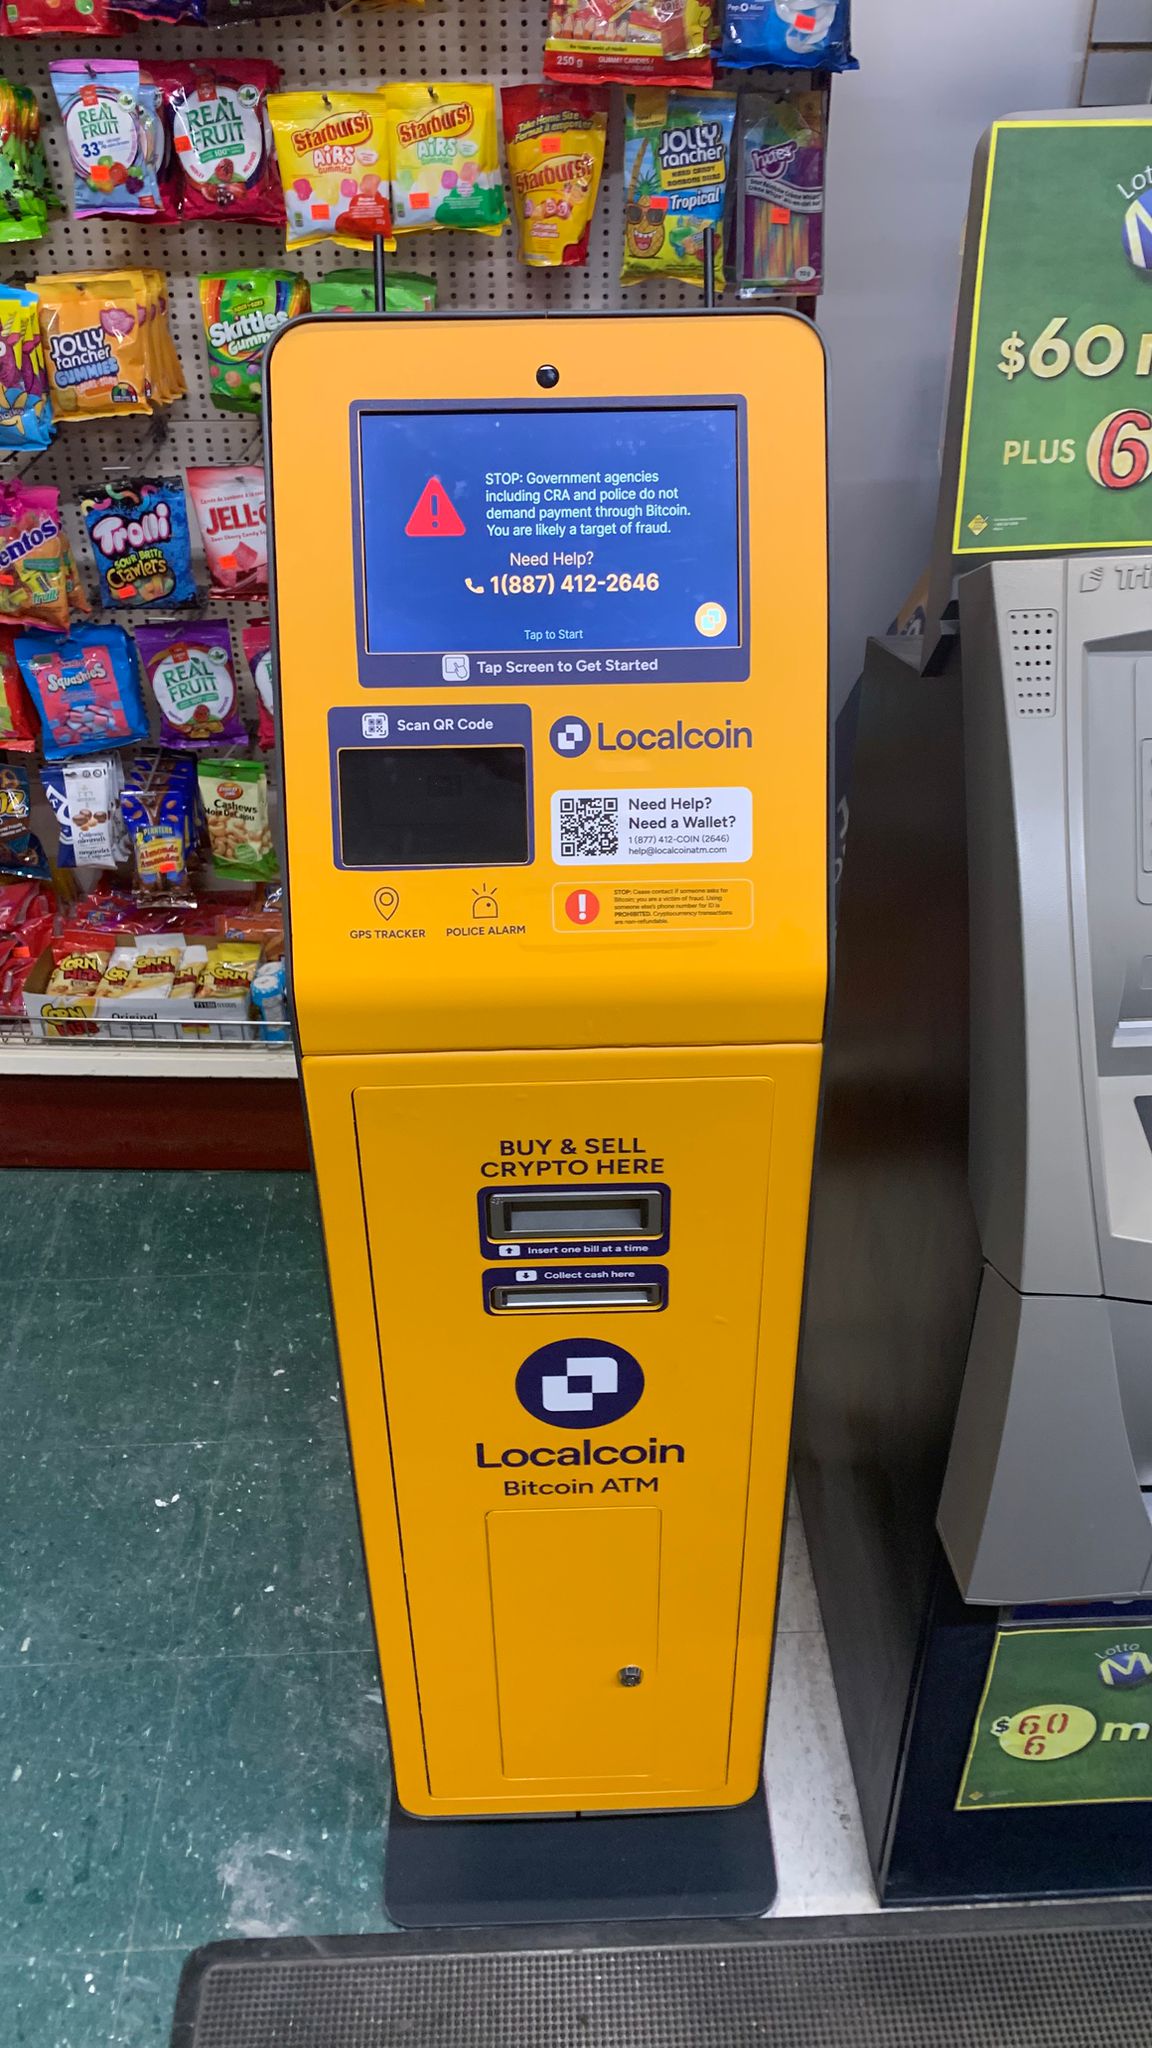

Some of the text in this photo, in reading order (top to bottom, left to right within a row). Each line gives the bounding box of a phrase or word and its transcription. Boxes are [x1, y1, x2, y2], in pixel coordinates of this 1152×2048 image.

[557, 56, 583, 68] 250 g
[78, 106, 117, 126] REAL
[186, 100, 242, 131] REAL
[400, 104, 472, 143] Starburst
[81, 121, 118, 140] FRUIT
[190, 122, 244, 148] FRUIT
[294, 112, 370, 151] Starburst
[659, 125, 718, 155] JOLLY
[664, 146, 722, 168] rancher
[516, 153, 594, 194] Starburst
[671, 186, 720, 210] Tropical
[210, 310, 288, 347] Skittles
[52, 329, 104, 359] JOLLY
[997, 317, 1125, 381] $60
[56, 346, 110, 370] rancher
[56, 358, 118, 388] GUMMIES
[1003, 410, 1152, 490] PLUS 6
[485, 470, 660, 486] STOP: Government agencies
[486, 487, 679, 504] including CRA and police do not
[486, 504, 691, 522] demand payment through Bitcoin.
[93, 503, 168, 556] Trolli
[486, 522, 671, 538] You are likely a target of fraud.
[114, 548, 164, 569] SOUR BRITE
[510, 550, 594, 568] Need Help?
[106, 559, 167, 588] Crawlers
[490, 572, 660, 596] 1(887) 412-2646
[524, 629, 584, 640] Tap to Start
[162, 660, 214, 686] REAL
[476, 658, 659, 676] Tap Screen to Get Started
[48, 662, 106, 692] Squashies
[168, 676, 218, 702] FRUIT
[397, 718, 494, 732] Scan QR Code
[597, 720, 753, 751] Localcoin
[214, 799, 258, 814] Cashews
[628, 797, 712, 812] Need Help?
[628, 815, 736, 830] Need a Wallet?
[634, 835, 656, 844] (877)
[658, 835, 700, 844] 412-COIN
[702, 834, 730, 843] (2646)
[140, 844, 178, 859] Almonds
[628, 846, 728, 856] help@localcoinatm.com
[350, 929, 426, 939] GPS TRACKER
[446, 926, 526, 936] POLICE ALARM
[60, 956, 97, 971] CORN
[133, 956, 172, 968] CORN
[212, 966, 248, 980] CORN
[41, 1003, 87, 1026] CORN
[500, 1137, 646, 1156] BUY & SELL
[480, 1158, 664, 1178] CRYPTO HERE
[528, 1246, 558, 1254] Insert
[584, 1244, 600, 1254] bill
[602, 1245, 613, 1253] at
[624, 1244, 649, 1252] time
[544, 1270, 635, 1280] Collect cash here
[476, 1438, 685, 1468] Localcoin
[504, 1477, 659, 1496] Bitcoin ATM
[1094, 1642, 1140, 1660] Lotto
